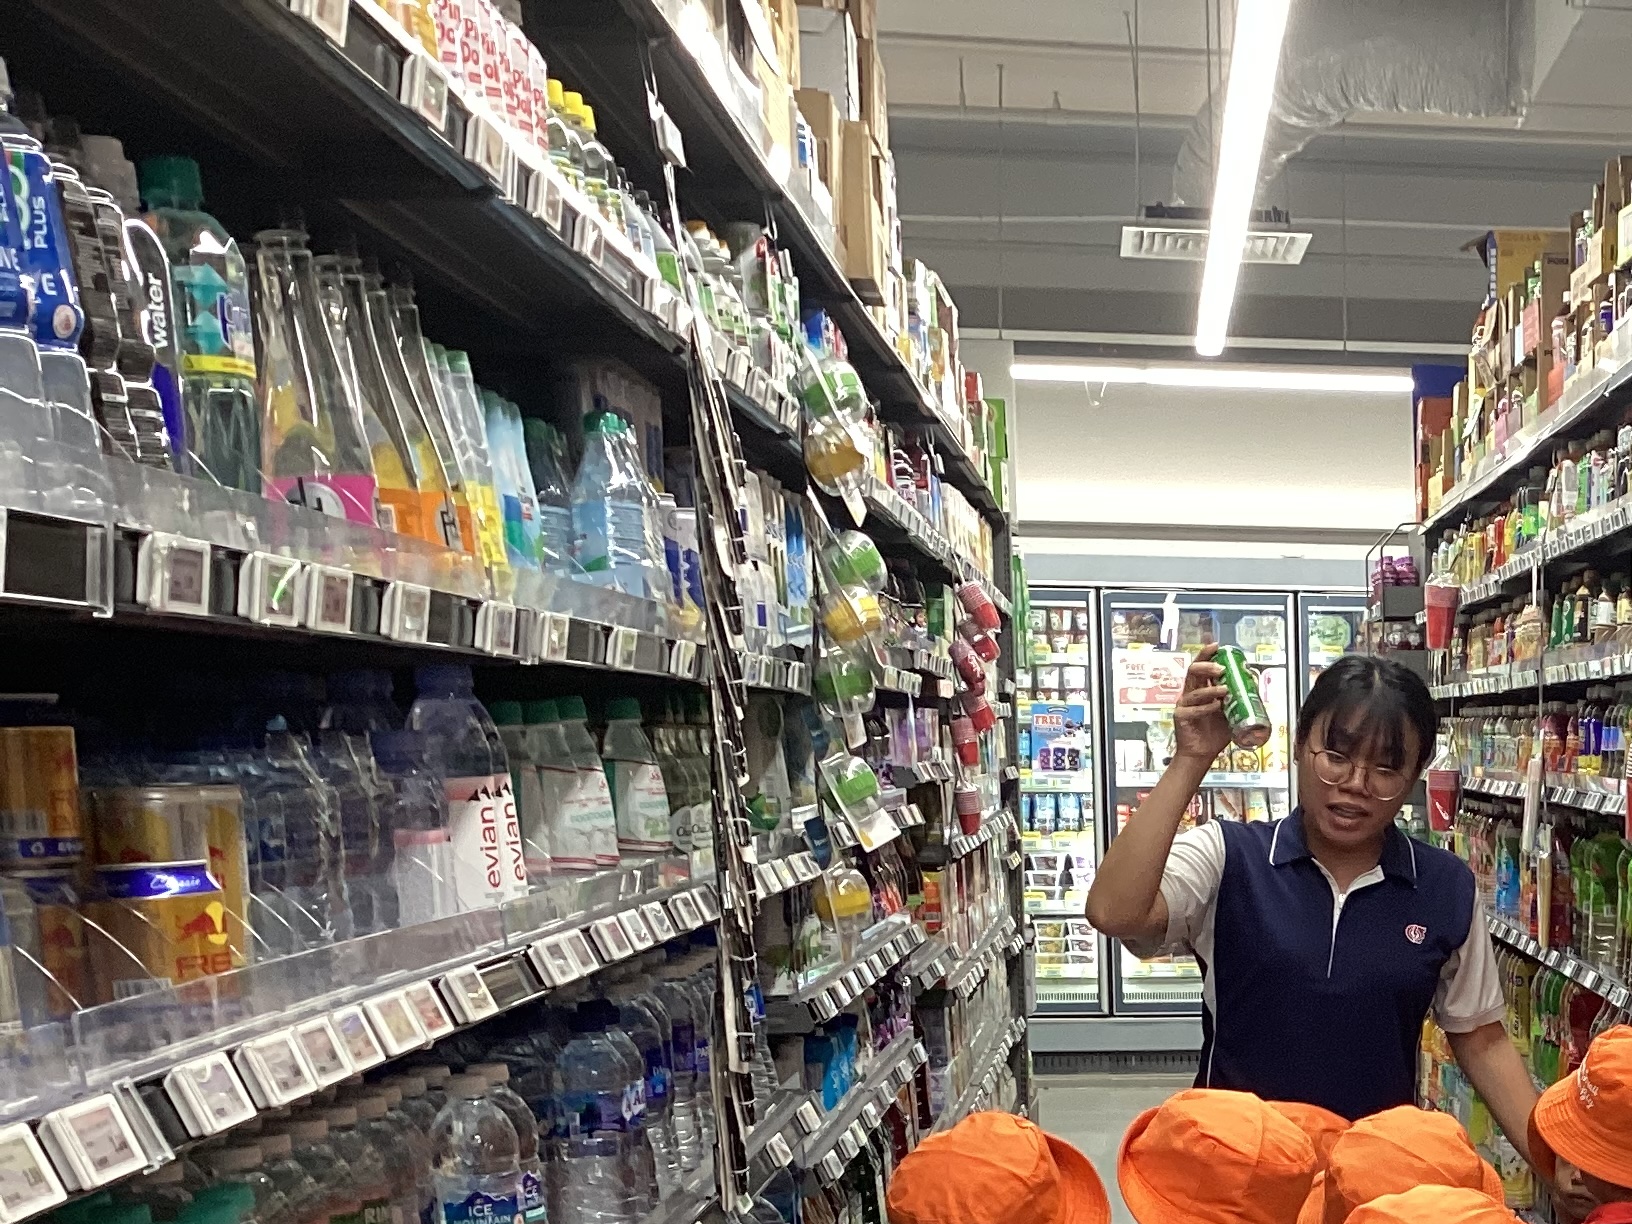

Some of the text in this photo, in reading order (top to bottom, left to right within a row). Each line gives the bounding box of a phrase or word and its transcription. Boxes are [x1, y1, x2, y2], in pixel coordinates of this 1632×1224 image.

[147, 271, 169, 349] water
[1034, 714, 1063, 727] FREE
[480, 805, 502, 889] evian
[504, 802, 526, 882] evian
[467, 1203, 494, 1217] ICE
